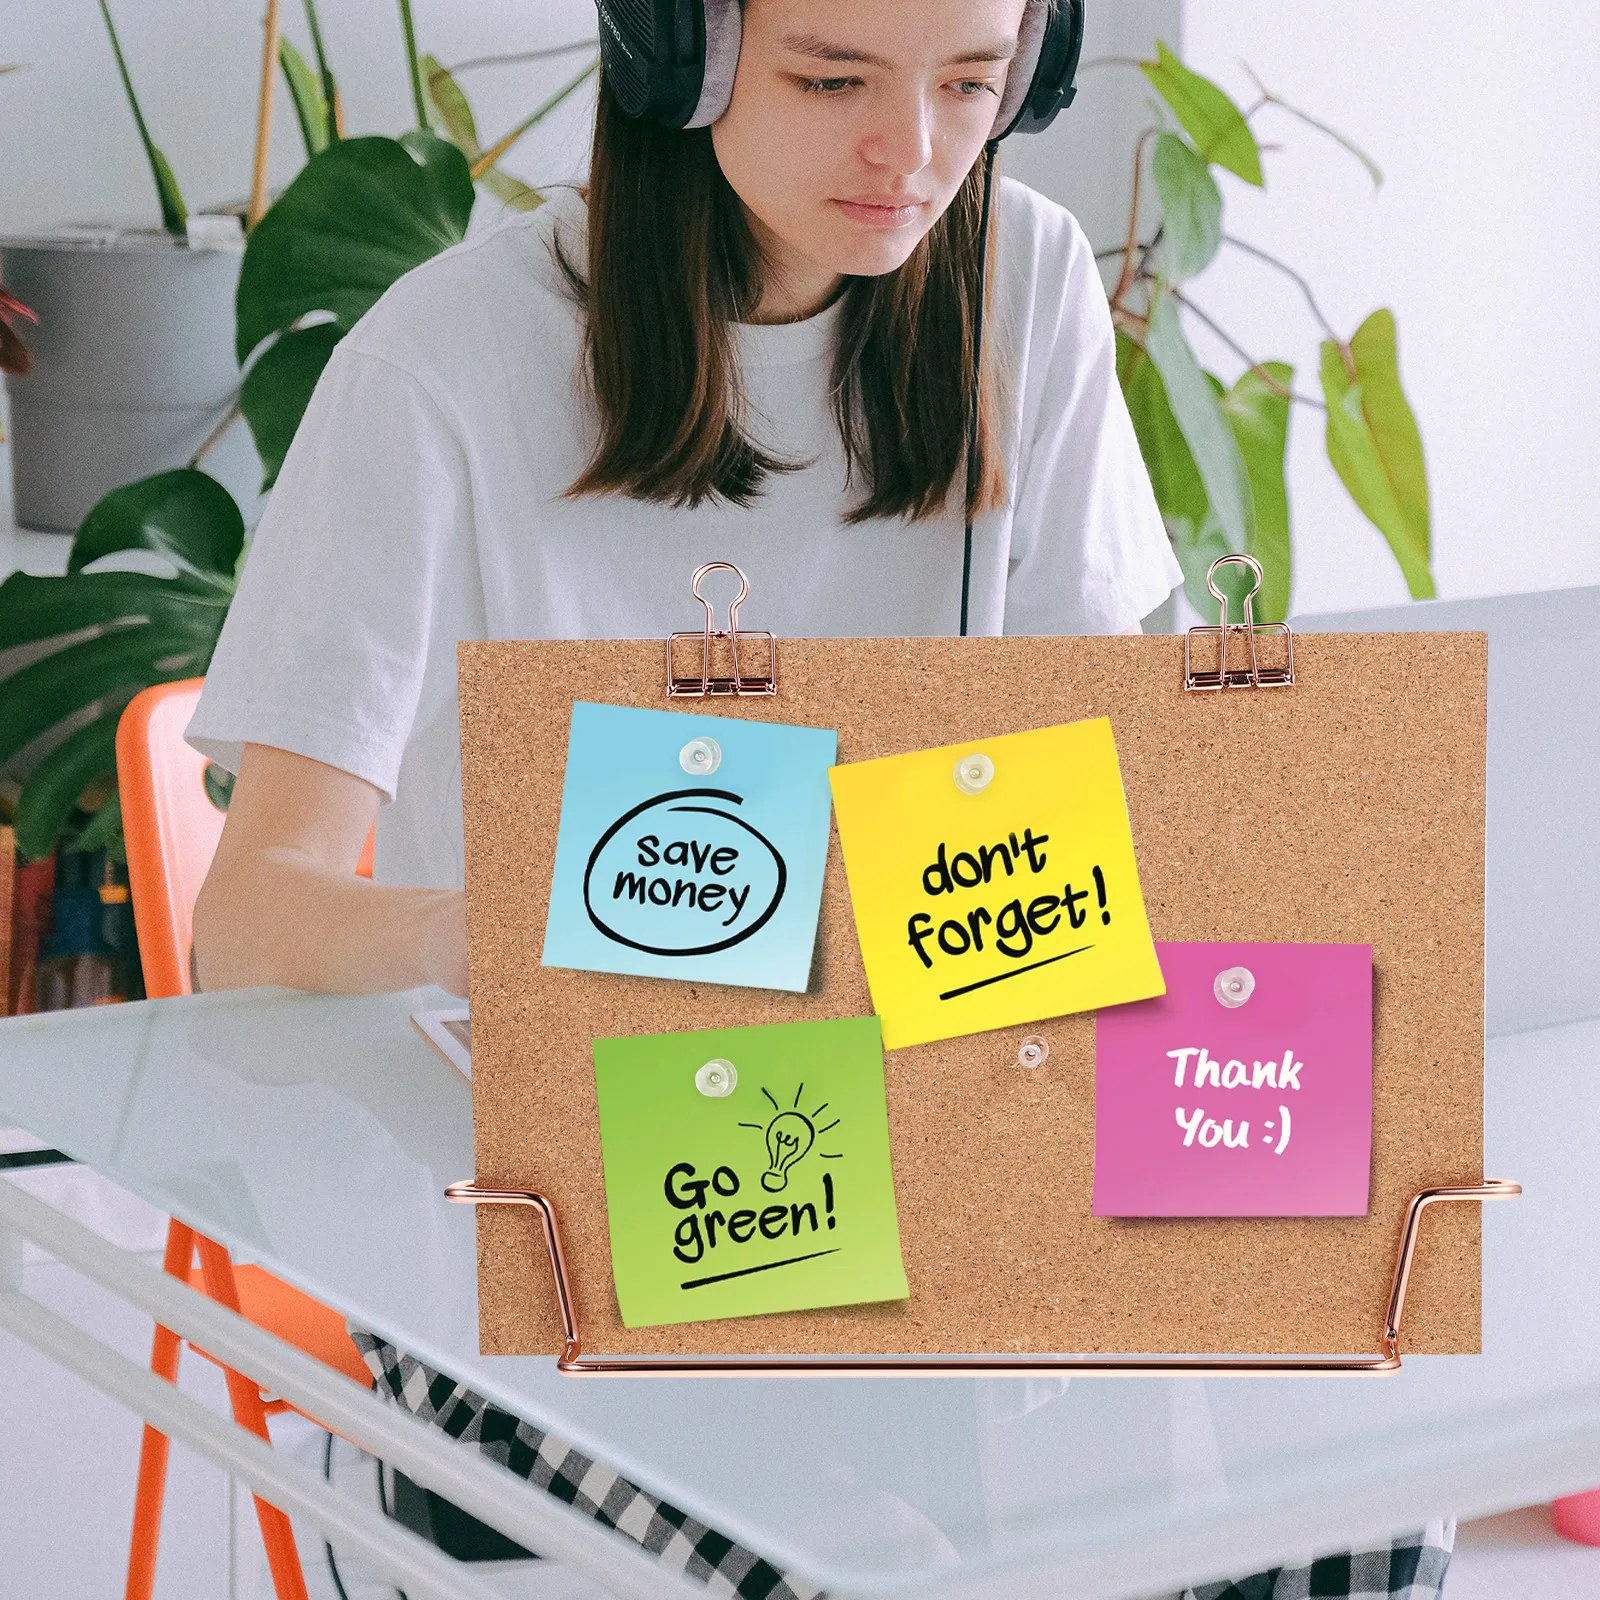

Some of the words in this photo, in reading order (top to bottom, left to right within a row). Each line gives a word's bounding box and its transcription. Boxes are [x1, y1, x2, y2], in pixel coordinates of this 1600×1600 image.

[636, 835, 739, 876] save
[921, 828, 1049, 896] don't
[612, 871, 751, 927] money
[907, 865, 1111, 969] forget!
[1166, 1047, 1305, 1091] Thank
[1175, 1107, 1250, 1150] You
[664, 1162, 740, 1210] Go
[673, 1172, 836, 1264] green!
